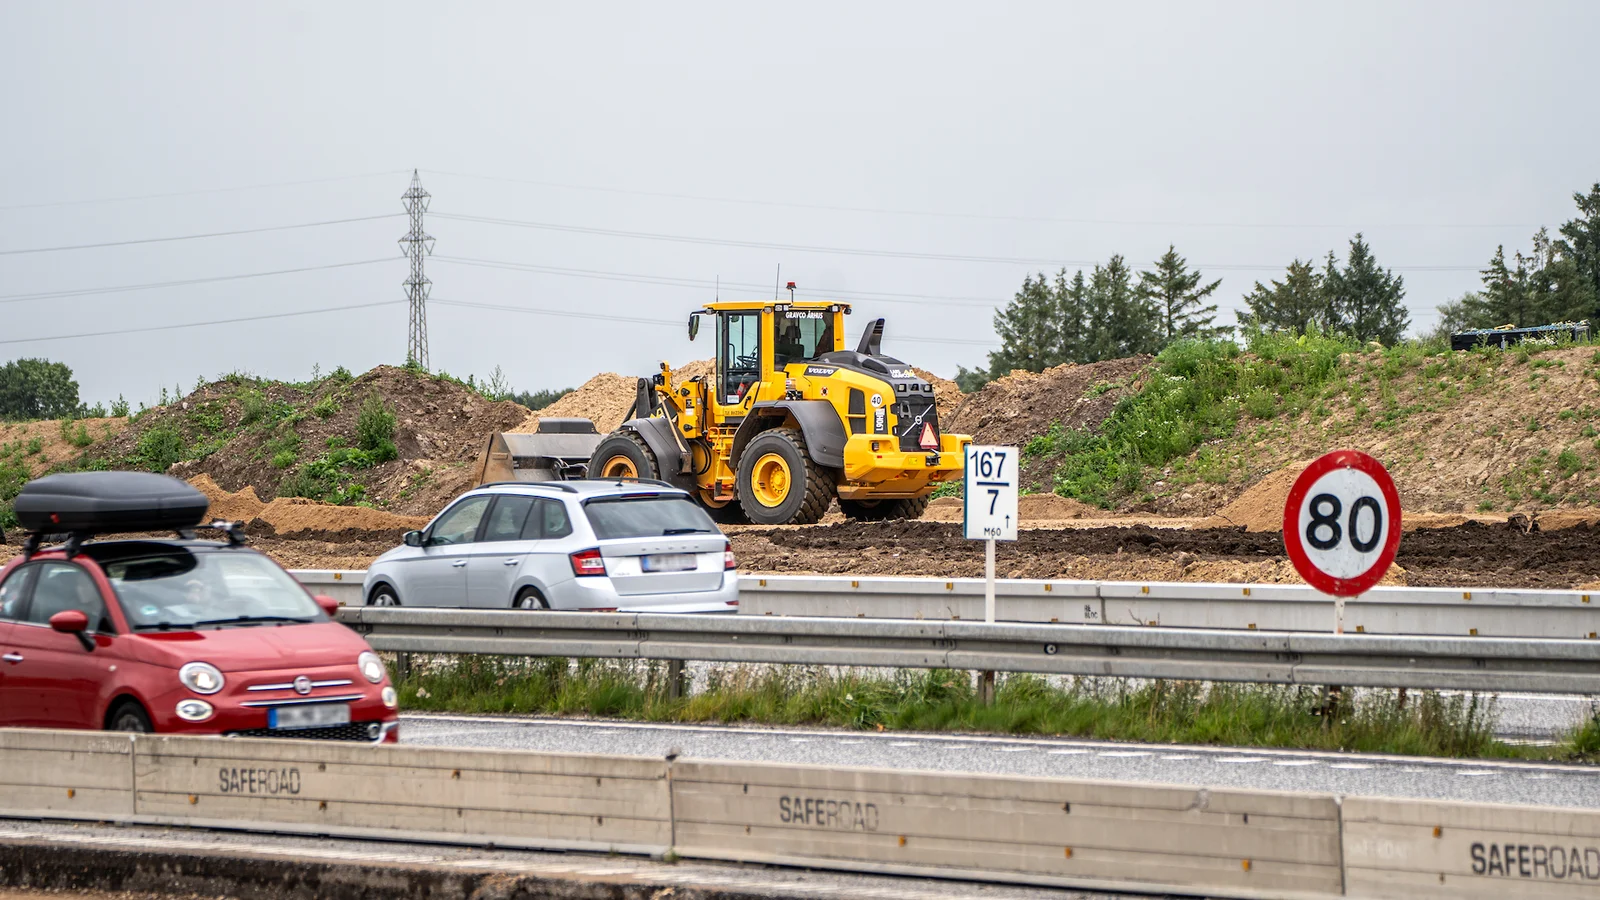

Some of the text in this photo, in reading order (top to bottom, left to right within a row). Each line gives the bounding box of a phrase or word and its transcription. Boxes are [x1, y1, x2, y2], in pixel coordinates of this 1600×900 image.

[785, 311, 806, 319] GRAVCO
[808, 367, 834, 375] VOLVO
[871, 396, 882, 405] 40
[970, 450, 1007, 479] 167
[987, 489, 1000, 516] 7
[983, 527, 1002, 537] M60
[1306, 493, 1383, 553] 80
[219, 767, 301, 795] SAFEROAD
[779, 795, 880, 832] SAFEROAD
[1470, 842, 1600, 880] SAFEROAD
